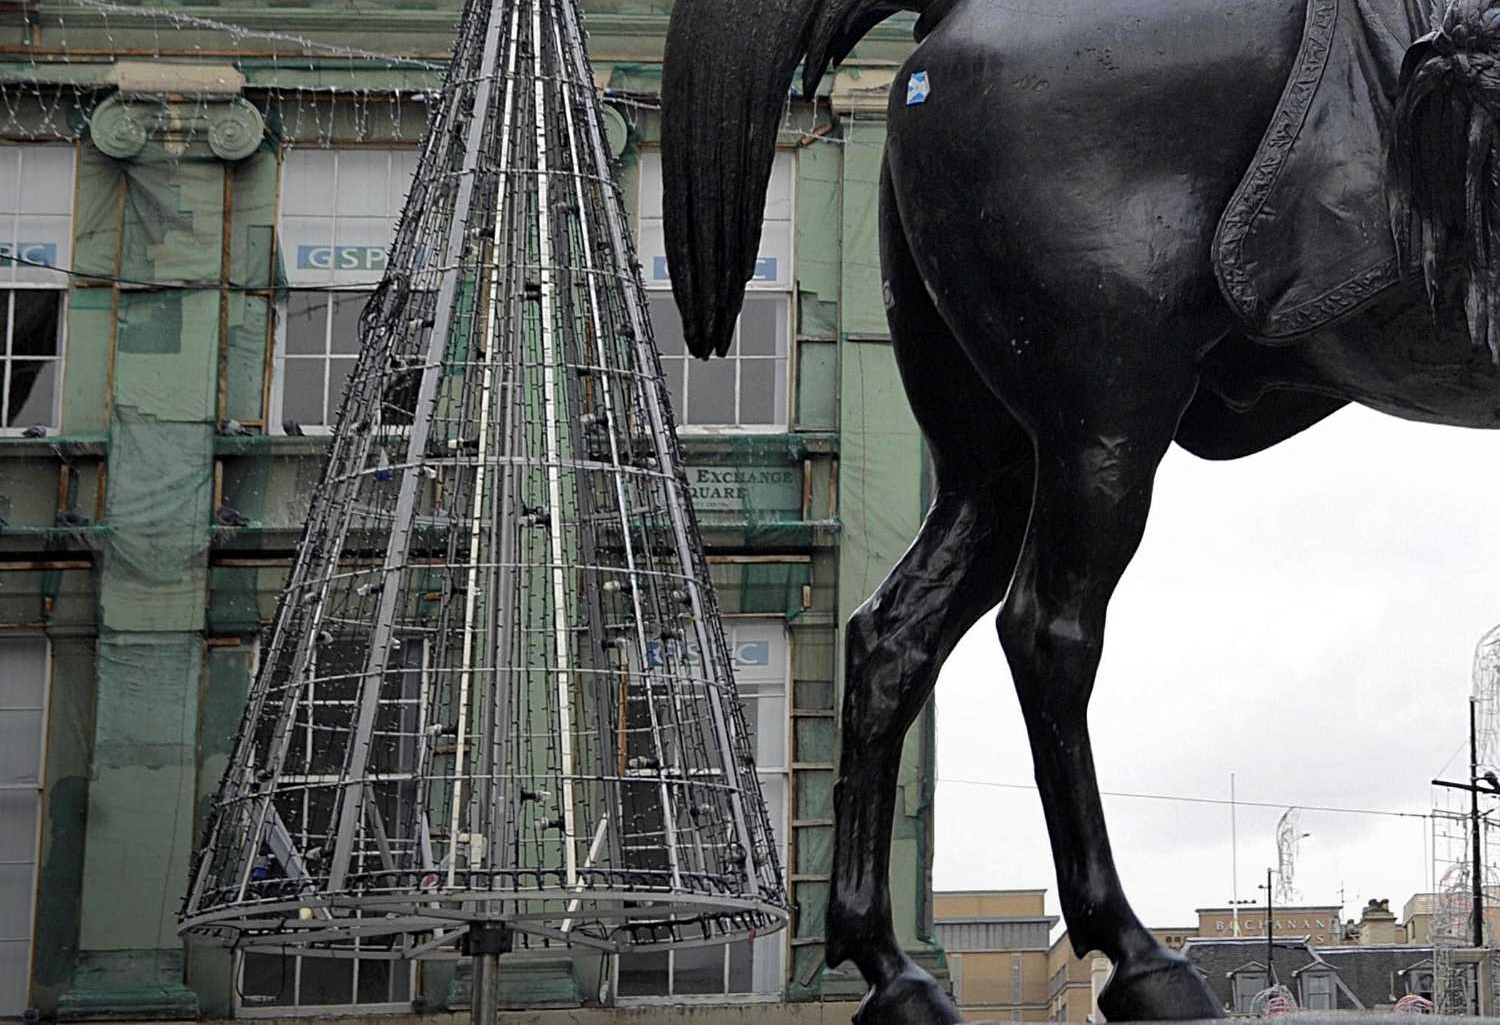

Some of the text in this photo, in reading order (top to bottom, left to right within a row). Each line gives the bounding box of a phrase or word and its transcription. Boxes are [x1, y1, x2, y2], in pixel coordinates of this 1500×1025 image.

[308, 248, 385, 268] GSP
[697, 469, 794, 484] EXCHANGE
[687, 486, 747, 499] QUARE
